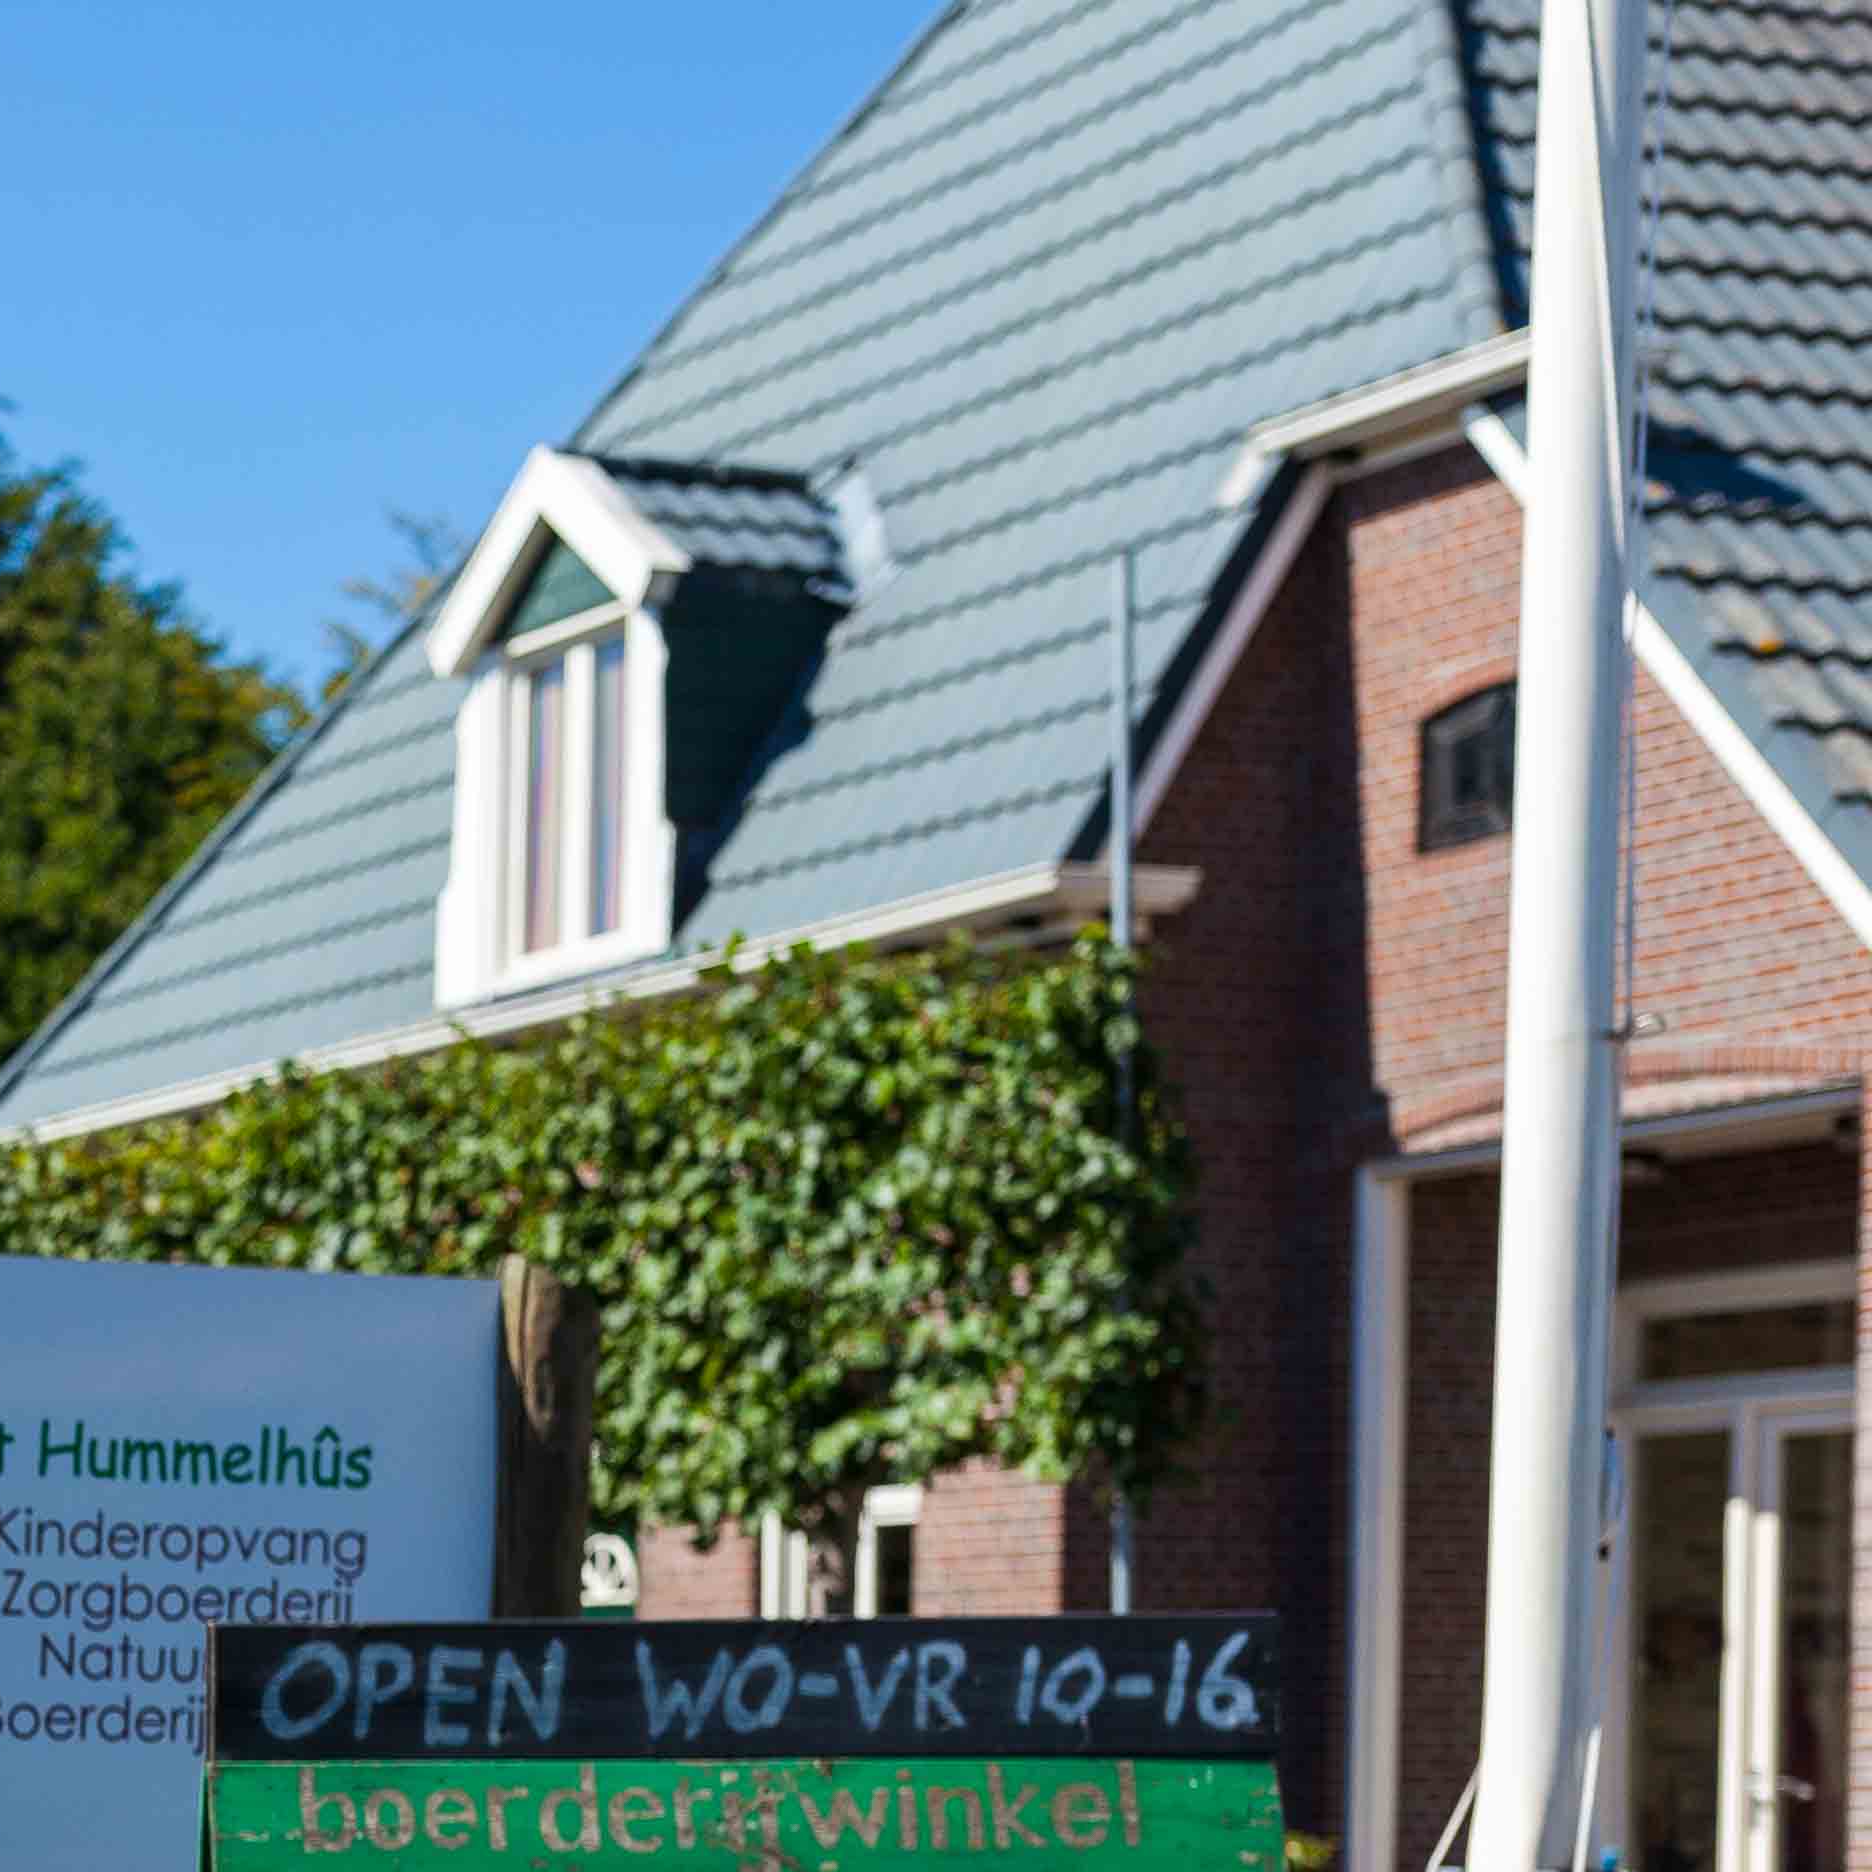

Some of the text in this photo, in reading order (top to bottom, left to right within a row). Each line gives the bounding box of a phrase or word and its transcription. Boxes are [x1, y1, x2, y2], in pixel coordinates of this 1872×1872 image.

[39, 1419, 373, 1490] Hummelhûs
[1, 1567, 354, 1633] Zorgboerderij
[38, 1632, 207, 1683] Natuu
[260, 1631, 1257, 1746] OPEN WO-VR 10-16
